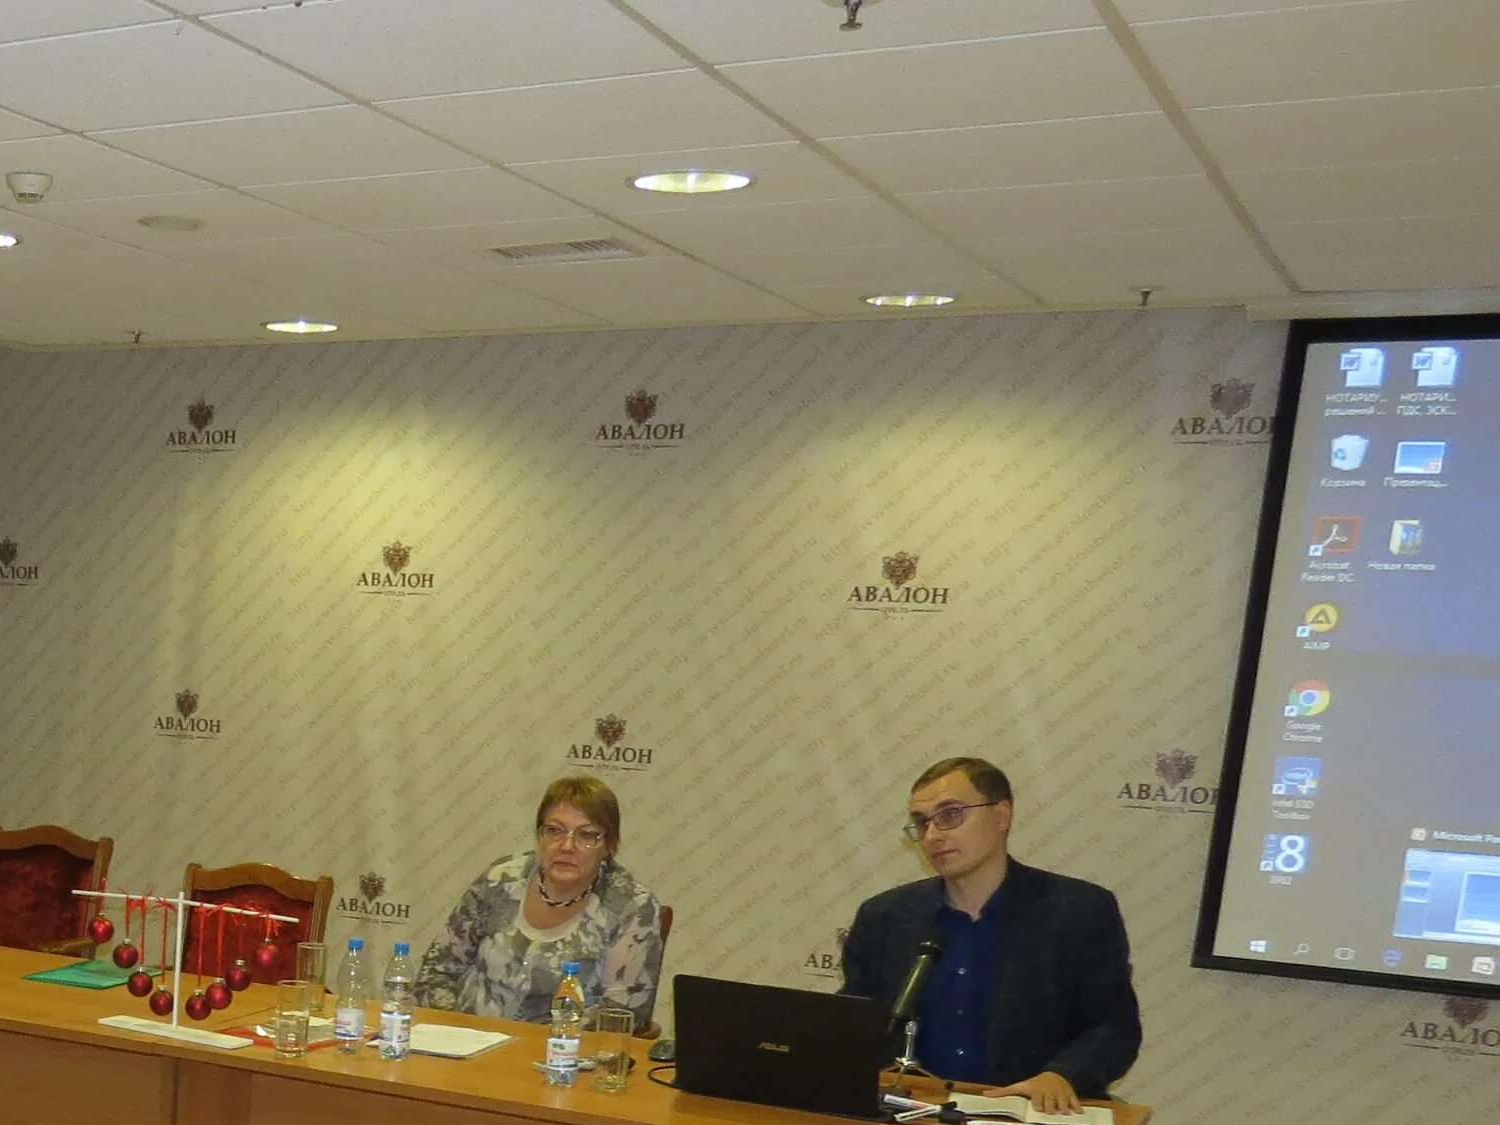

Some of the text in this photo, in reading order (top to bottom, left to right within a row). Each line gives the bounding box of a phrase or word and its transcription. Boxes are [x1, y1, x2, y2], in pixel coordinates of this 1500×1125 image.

[166, 429, 237, 446] АВАЛОН
[595, 422, 686, 442] АВАЛОН
[356, 572, 435, 590] АВАЛОН
[847, 585, 950, 605] АВАЛОН
[153, 715, 222, 733] АВАЛОН
[566, 744, 654, 764] АВАЛОН
[334, 897, 410, 919] АВАЛОН
